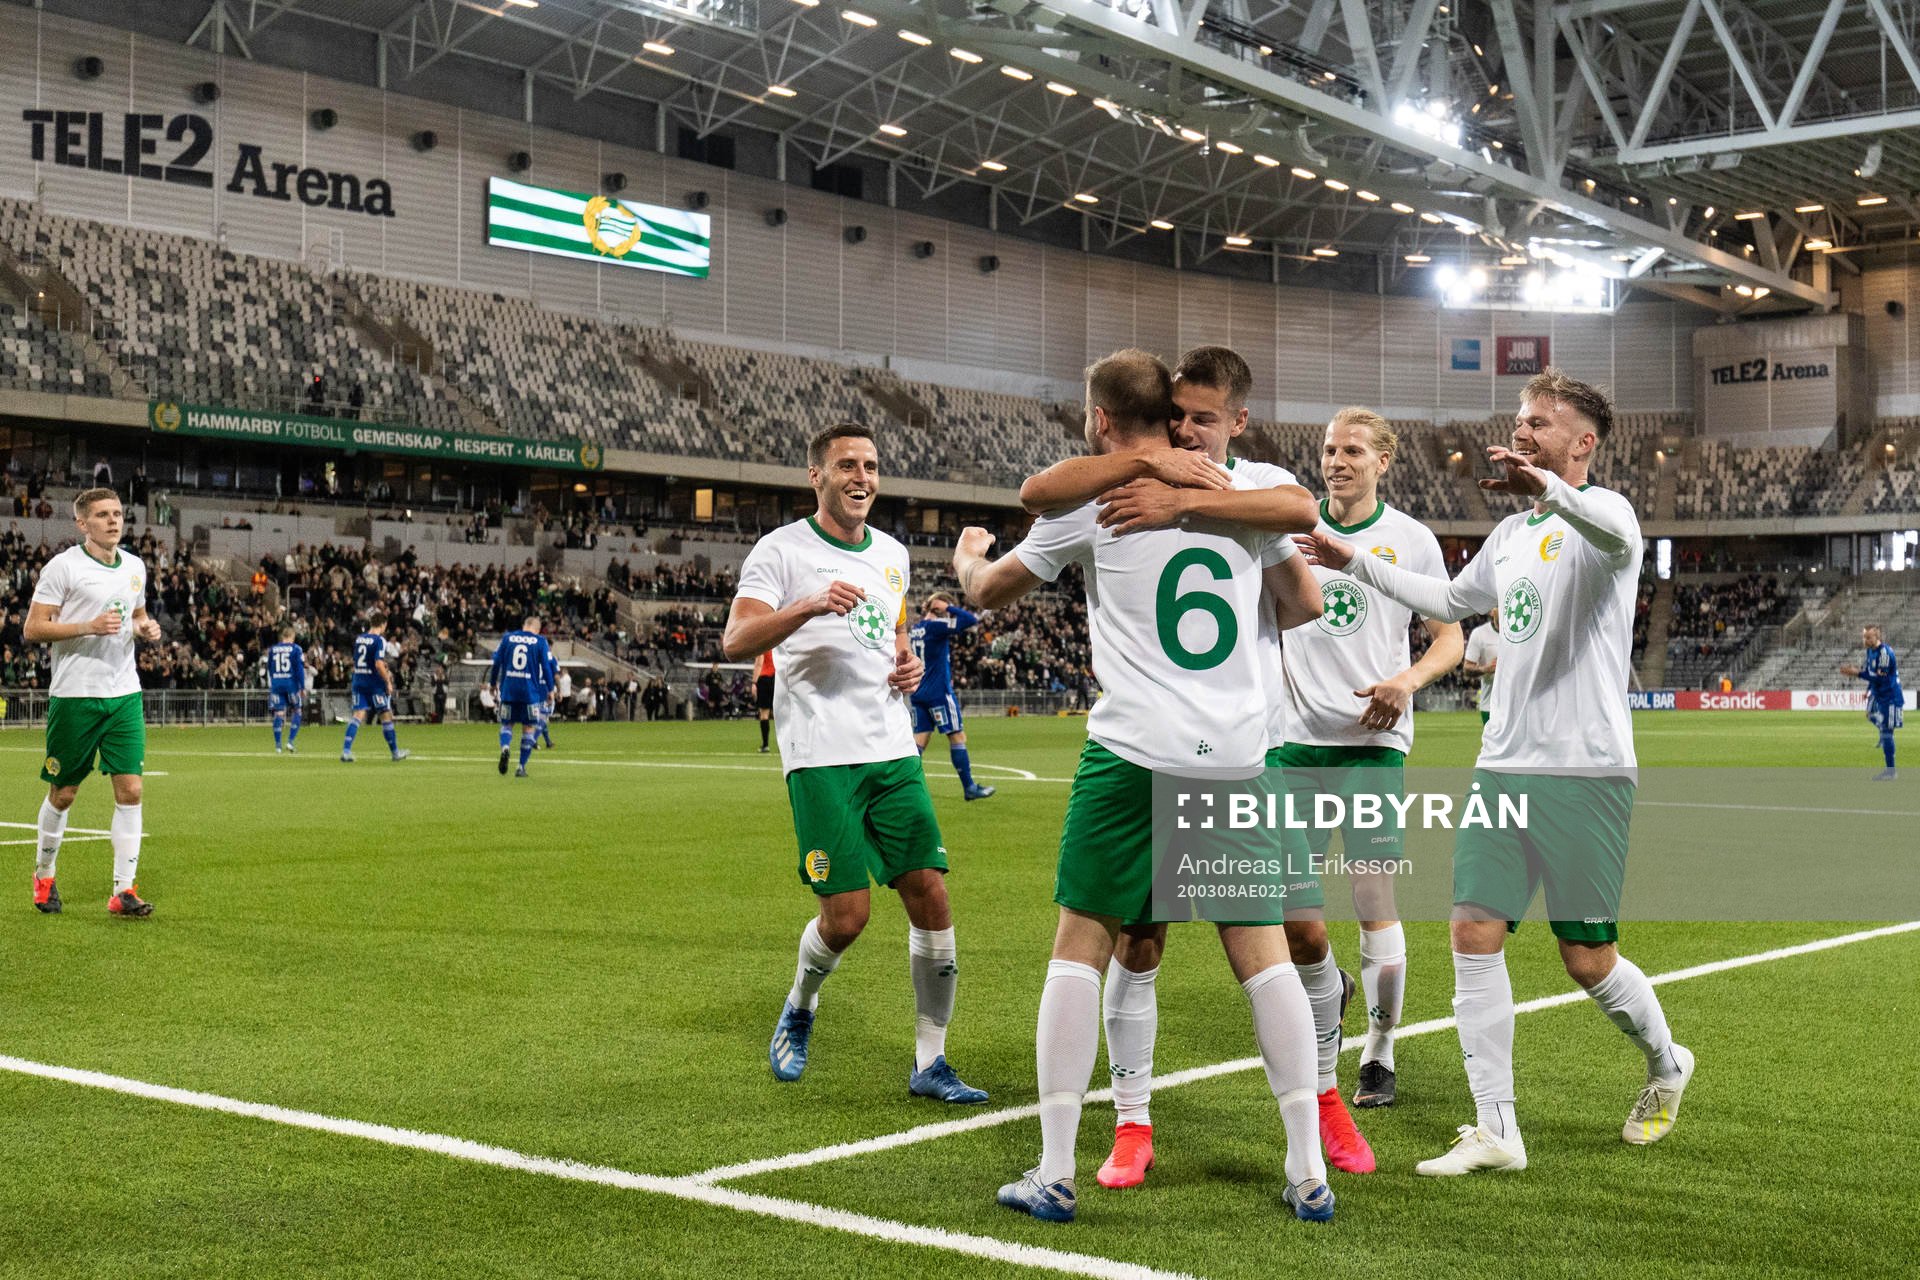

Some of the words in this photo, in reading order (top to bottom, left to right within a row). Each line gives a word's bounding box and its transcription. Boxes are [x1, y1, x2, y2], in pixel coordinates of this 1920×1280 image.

[23, 109, 214, 188] TELE2
[226, 143, 396, 218] Arena
[1508, 341, 1535, 359] JOB
[1711, 358, 1767, 385] TELE2
[1771, 362, 1829, 380] Arena
[187, 411, 282, 435] HAMMARBY
[285, 421, 346, 442] FOTBOLL
[353, 428, 442, 450] GEMENSKAP
[454, 438, 514, 457] RESPEKT
[525, 444, 575, 463] KÄRLEK
[1155, 547, 1238, 671] 6
[272, 652, 291, 673] 15
[357, 644, 367, 667] 2
[512, 644, 528, 670] 6
[1653, 692, 1675, 709] BAR
[1700, 692, 1766, 710] Scandic
[1371, 836, 1395, 844] CRAFT
[1289, 881, 1316, 891] CRAFT
[1584, 916, 1609, 924] CRAFT
